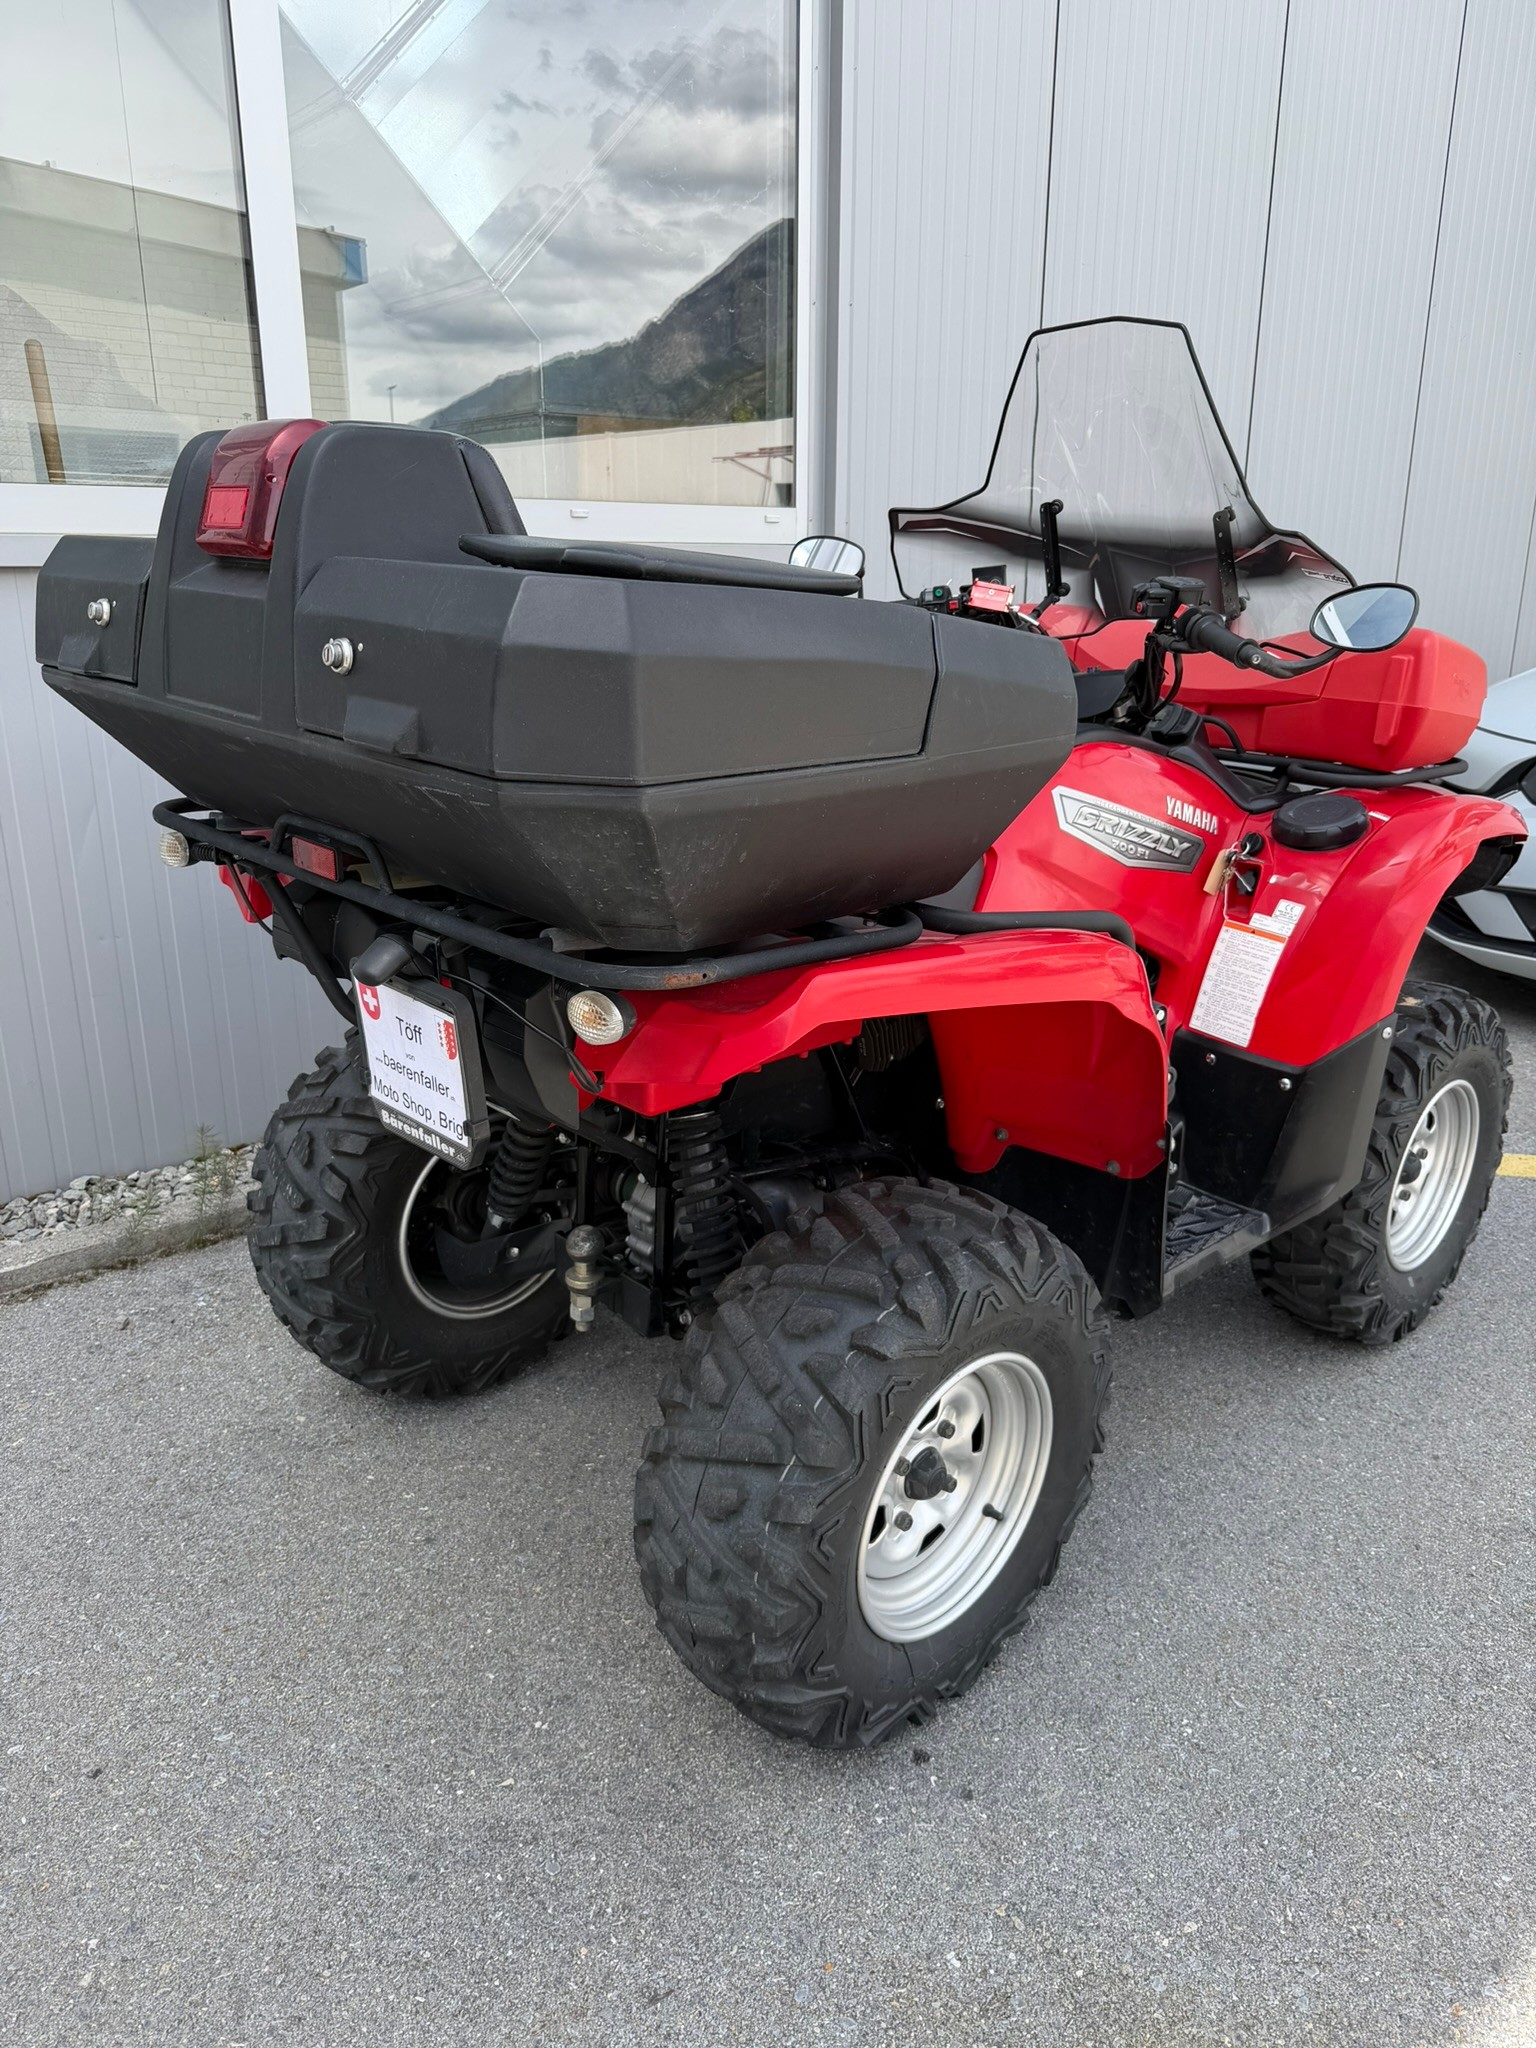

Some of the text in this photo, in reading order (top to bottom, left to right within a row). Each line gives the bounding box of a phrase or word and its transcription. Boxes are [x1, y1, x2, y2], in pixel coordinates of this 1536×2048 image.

[1072, 806, 1192, 859] GRIZZLY
[1166, 796, 1219, 835] YAMAHA
[395, 1016, 423, 1045] Töff
[405, 1052, 416, 1061] von
[373, 1075, 399, 1103] Moto
[402, 1093, 436, 1125] Shop,
[439, 1112, 464, 1141] Brig
